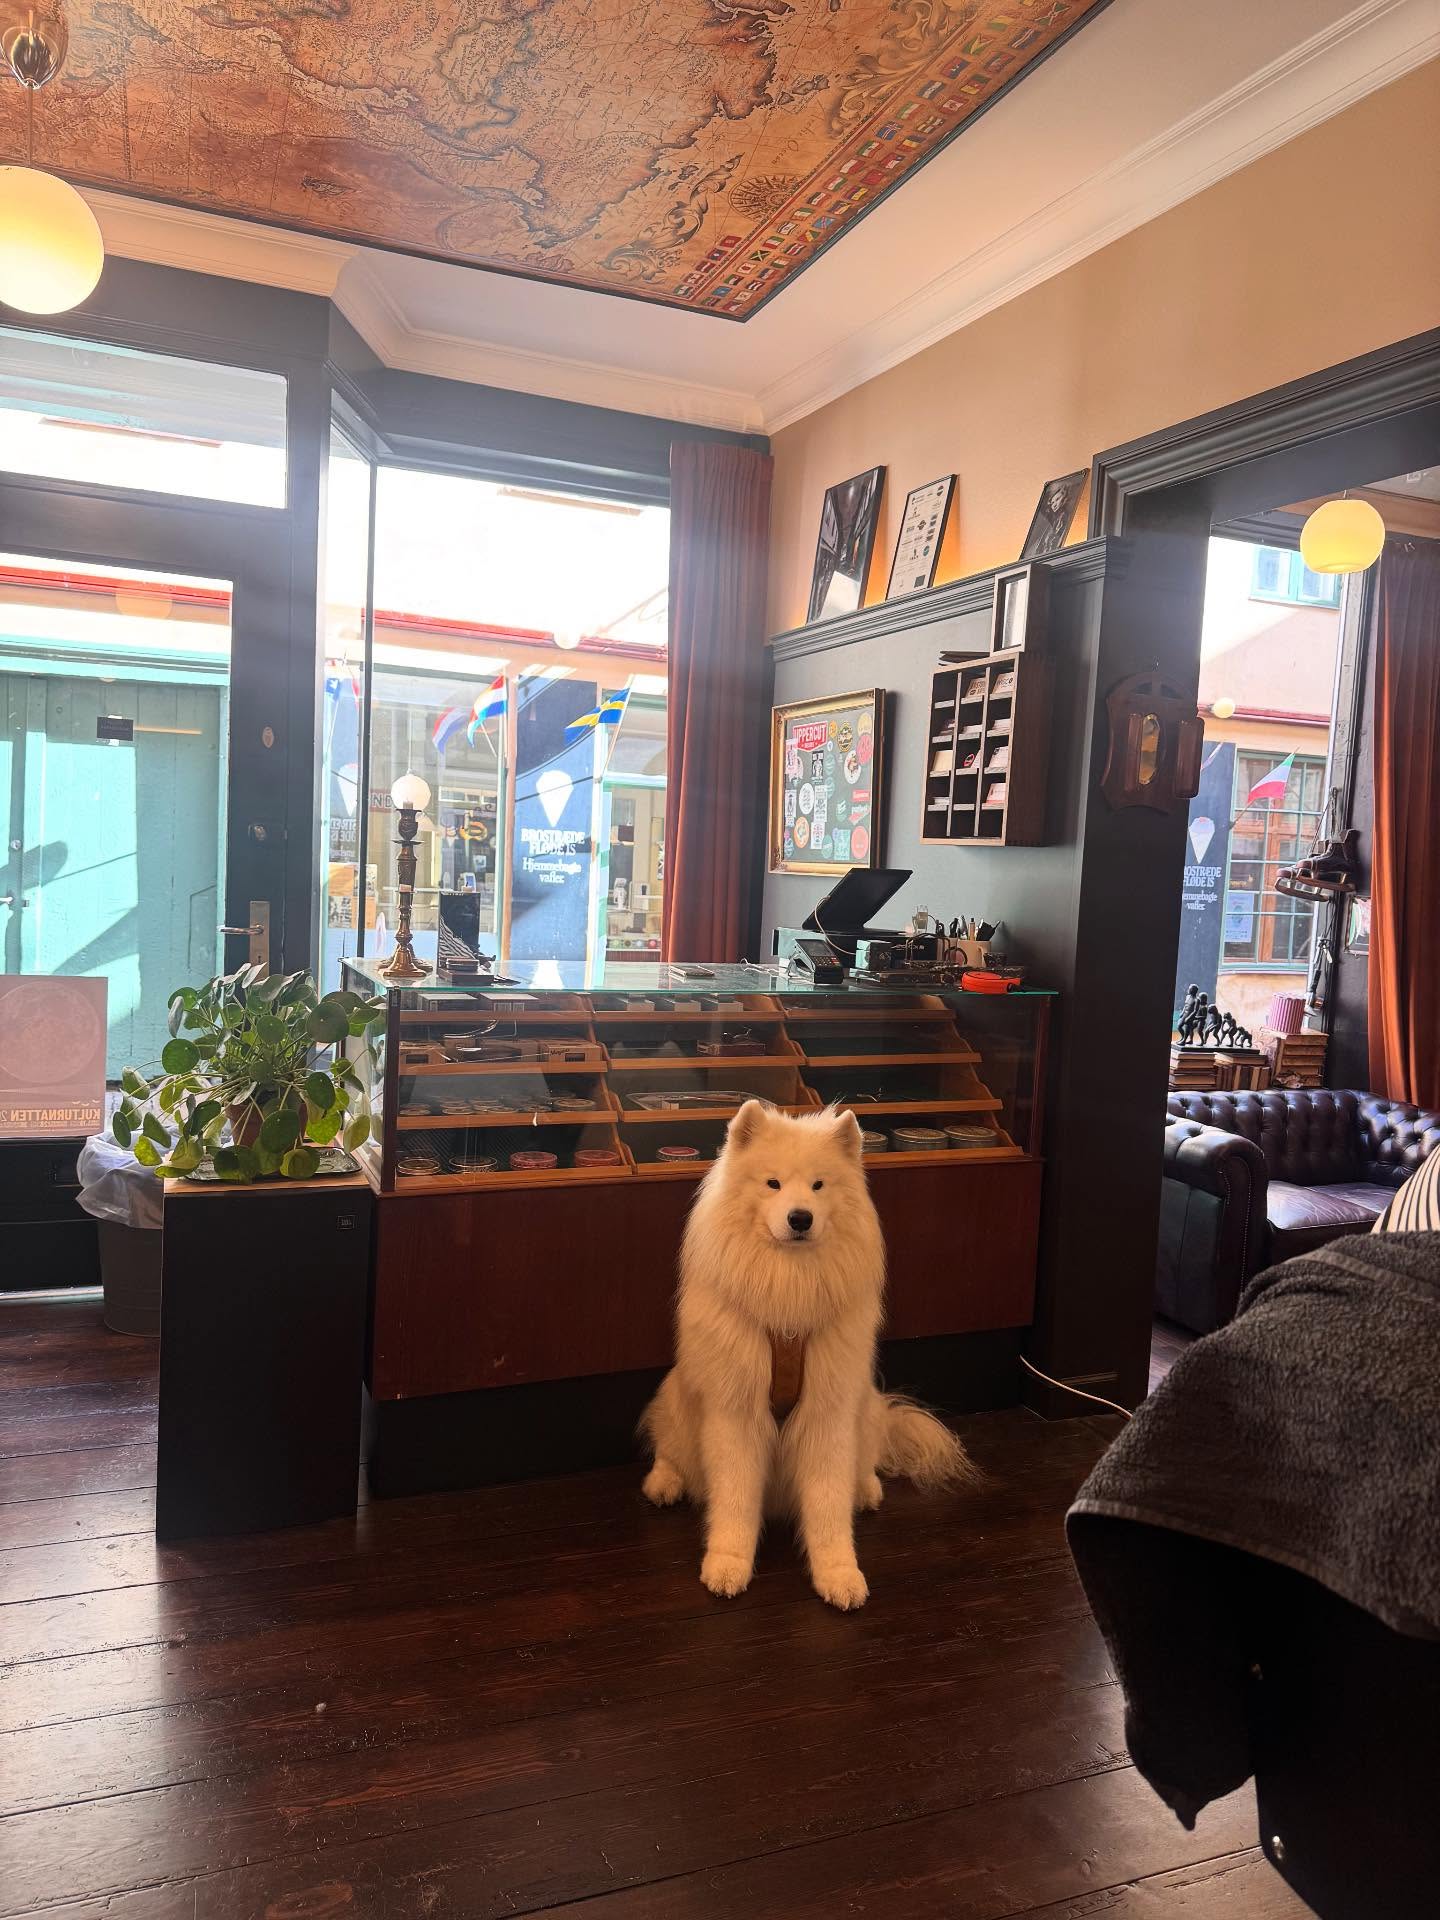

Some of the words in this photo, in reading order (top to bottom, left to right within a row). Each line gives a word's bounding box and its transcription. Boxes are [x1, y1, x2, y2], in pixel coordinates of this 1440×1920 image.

[794, 725, 826, 743] UPPERCUT
[521, 828, 586, 844] BROSTRÆDE
[529, 840, 564, 856] FLØDE
